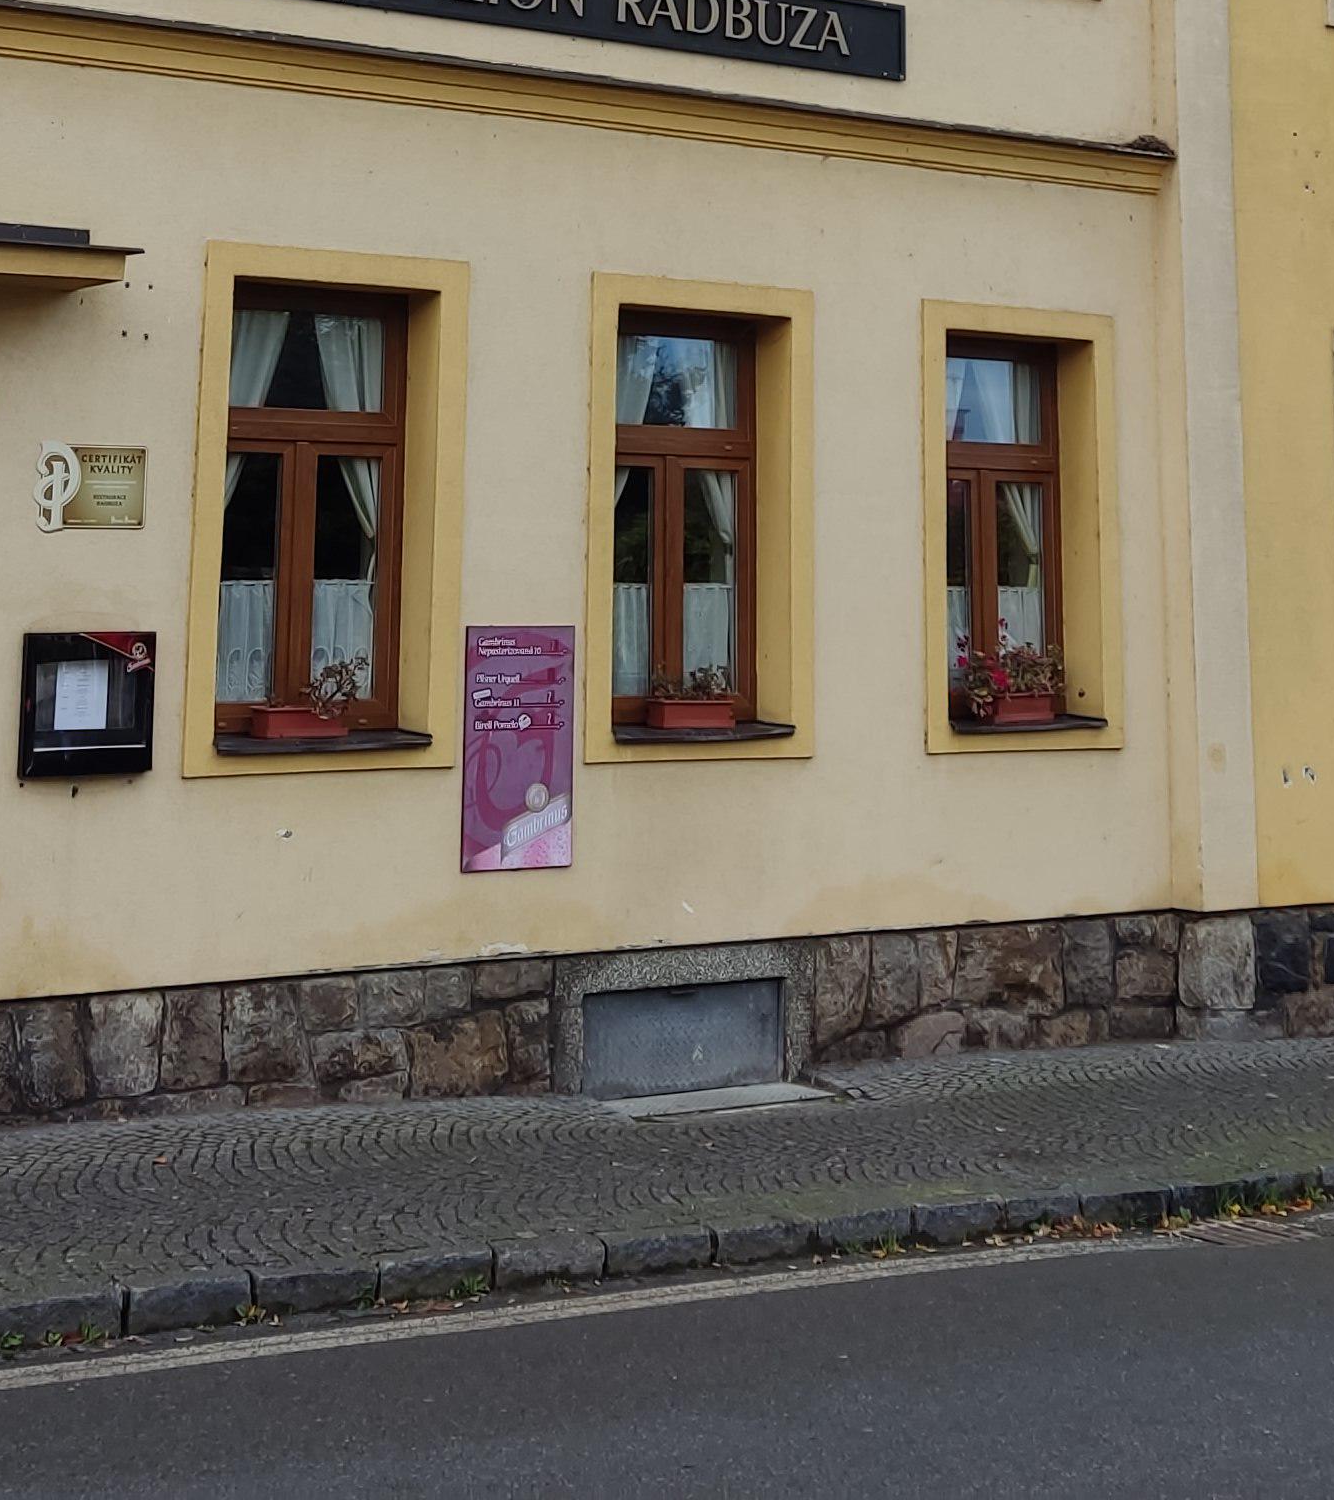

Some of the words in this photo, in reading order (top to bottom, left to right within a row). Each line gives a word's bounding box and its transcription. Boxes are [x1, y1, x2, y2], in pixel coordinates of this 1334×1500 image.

[89, 465, 134, 475] KVALITY
[533, 647, 542, 655] 10
[503, 804, 568, 847] Gambrinus
